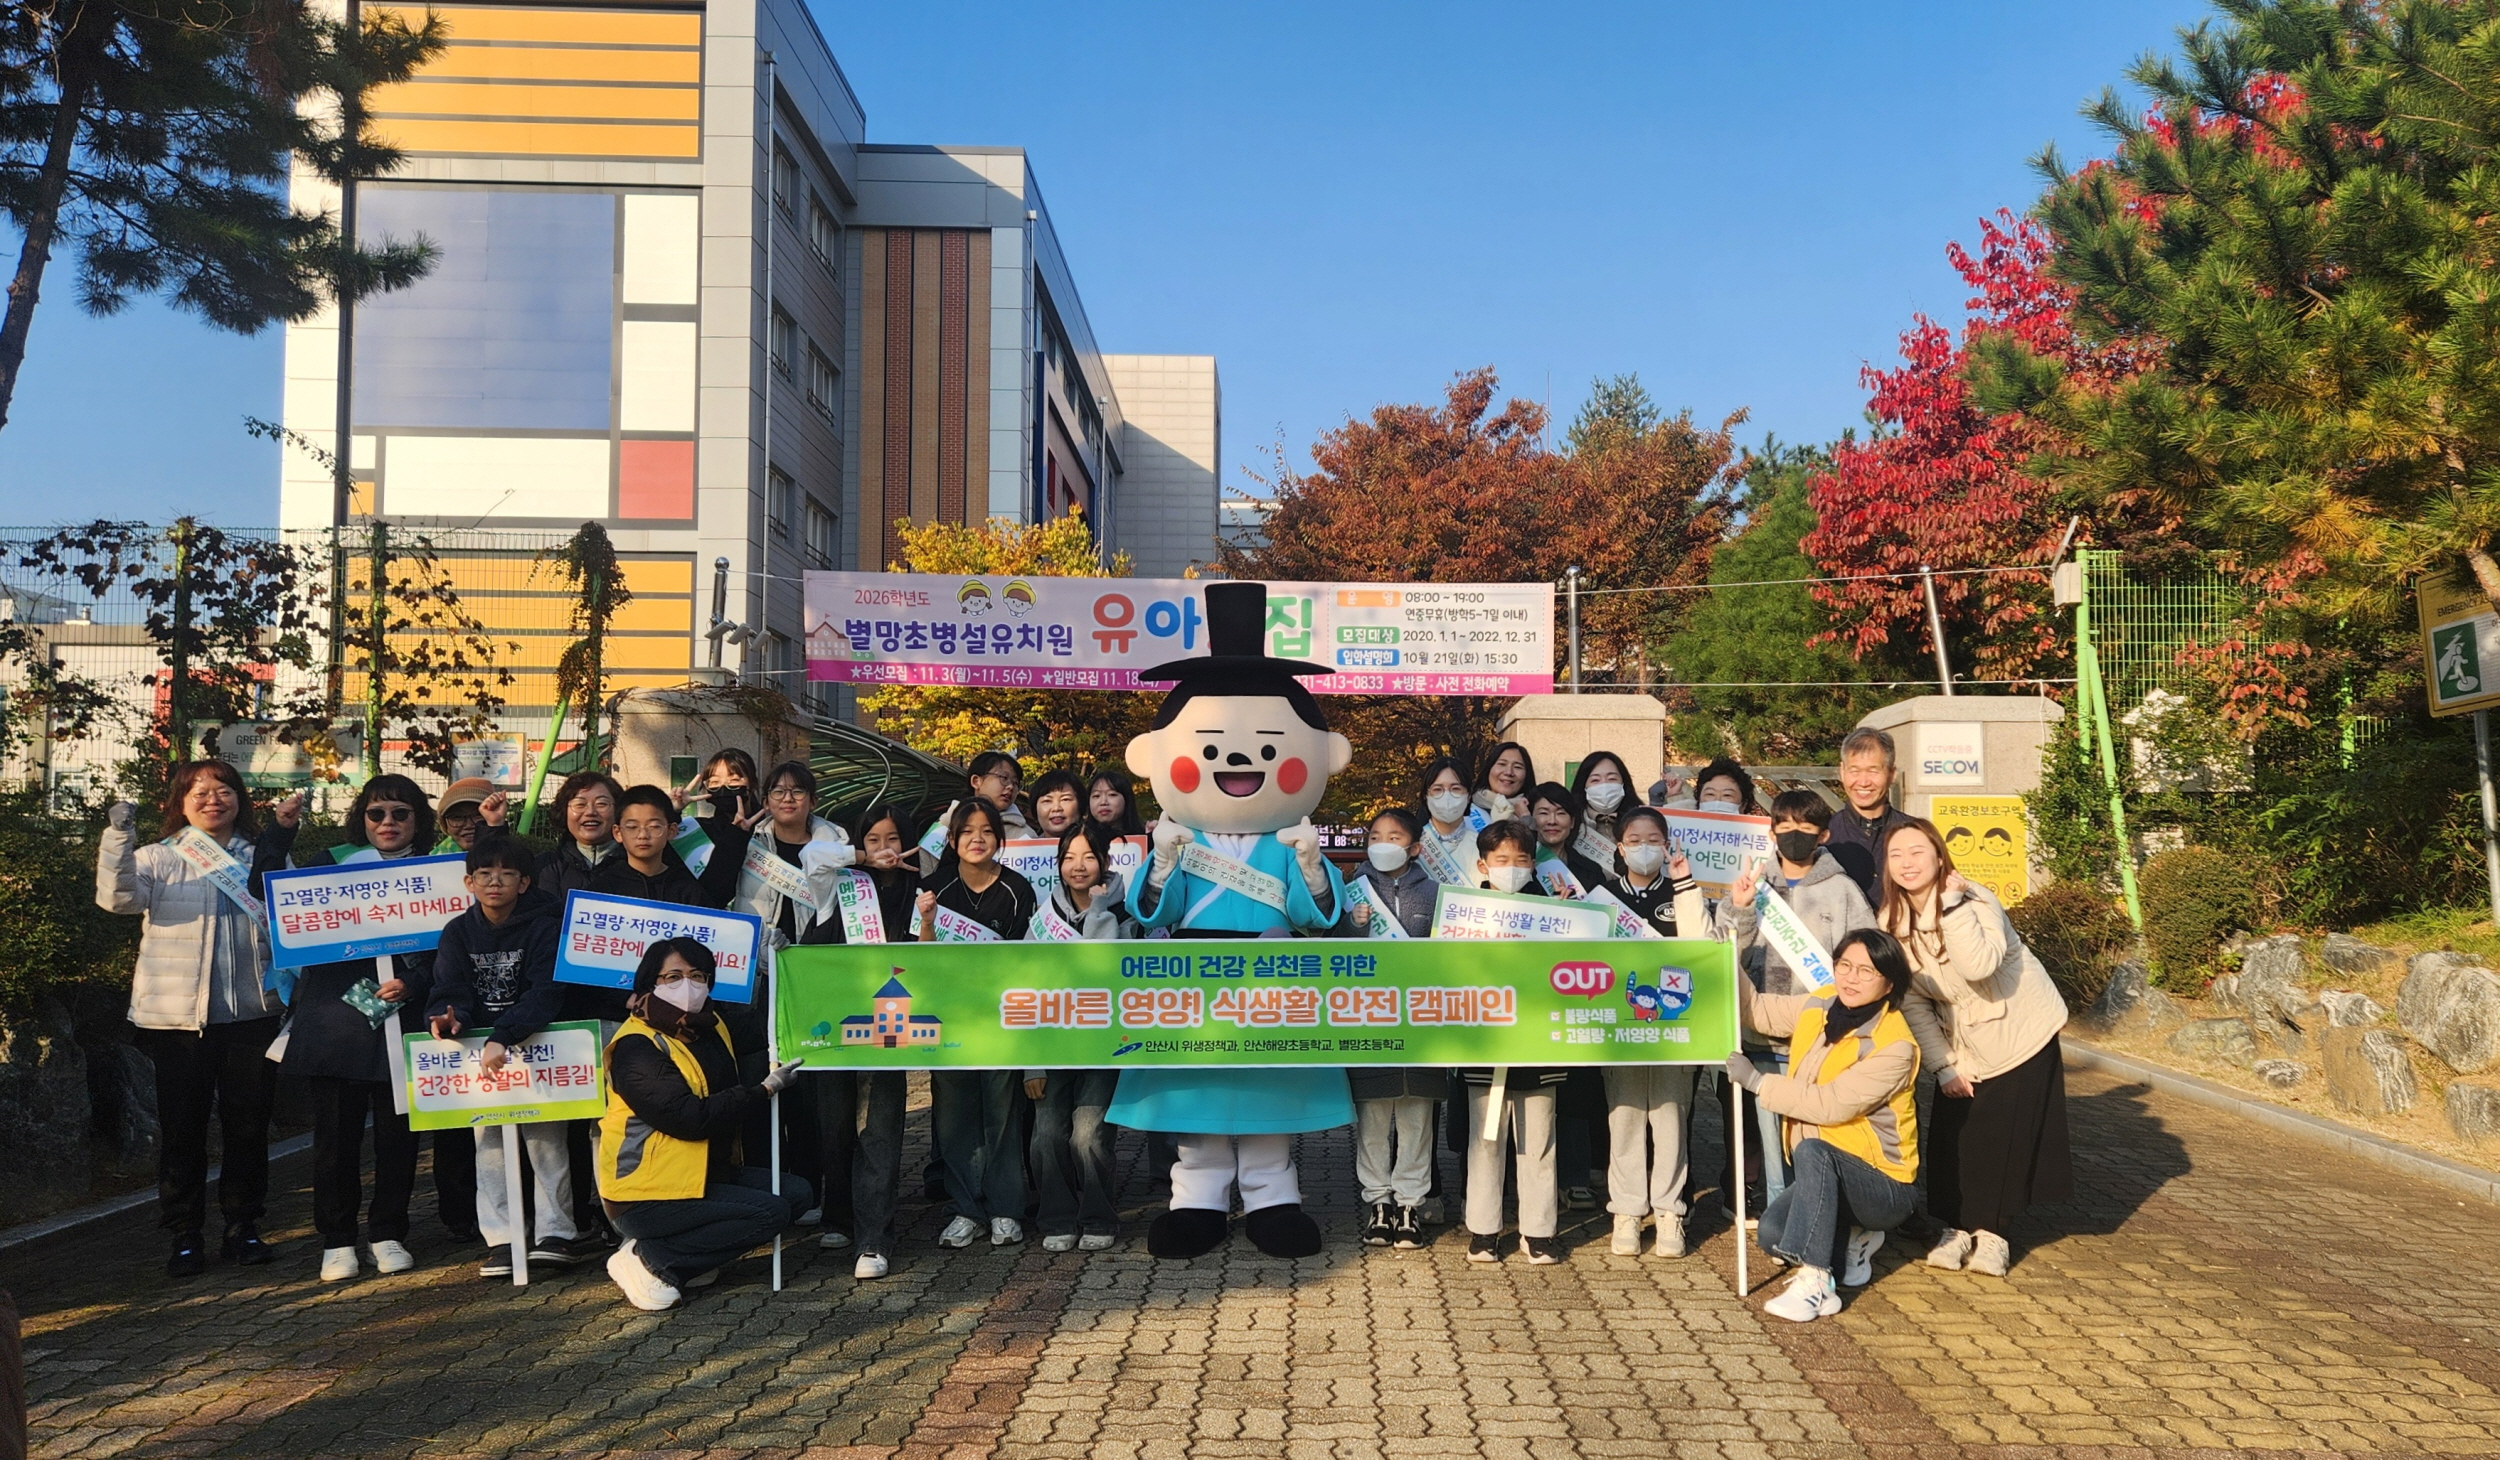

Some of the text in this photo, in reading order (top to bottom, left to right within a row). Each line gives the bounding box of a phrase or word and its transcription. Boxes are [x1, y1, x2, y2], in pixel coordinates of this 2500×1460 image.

[854, 589, 931, 606] 2026학년도
[1405, 592, 1440, 603] 08:00
[1453, 592, 1485, 603] 19:00
[1503, 608, 1529, 622] 이내)
[1091, 592, 1313, 658] 유아집
[845, 618, 1074, 656] 별망초병설유치원
[1342, 628, 1394, 643] 모집대상
[1525, 631, 1537, 642] 31
[1342, 651, 1518, 666] 입학설명회 10월 21일(화) 15:30
[862, 665, 908, 682] 우선모집
[1053, 669, 1100, 686] 일반모집
[1403, 675, 1426, 692] 방문
[1435, 675, 1460, 692] 사전
[1462, 675, 1510, 692] 전화예약
[236, 735, 266, 746] GREEN
[1928, 745, 1973, 754] CCTV작동중
[1923, 760, 1979, 774] SECOM
[1938, 805, 2021, 817] 교육환경보호구역
[1695, 850, 1742, 871] 어린이
[280, 880, 390, 907] 고열량·저영양
[394, 876, 432, 896] 식품!
[838, 880, 857, 908] 예방
[281, 895, 471, 935] 달콤함에 속지 마세요!
[1445, 903, 1572, 935] 올바른 식생활 실천!
[575, 911, 678, 939] 고열량·저영양
[573, 932, 645, 957] 달콤함에
[1121, 954, 1377, 979] 어린이 건강 실천을 위한
[1553, 967, 1611, 990] OUT
[1002, 988, 1514, 1027] 올바른 영양! 식생활 안전 캠페인
[1565, 1008, 1617, 1025] 불량식품
[1663, 1027, 1691, 1044] 식품
[1145, 1037, 1405, 1054] 안산시 위생정책과, 안산해양초등학교, 별망초등학교
[416, 1051, 462, 1071] 올바른
[520, 1044, 554, 1064] 실천!
[418, 1064, 594, 1097] 건강한 생활의 지름길!
